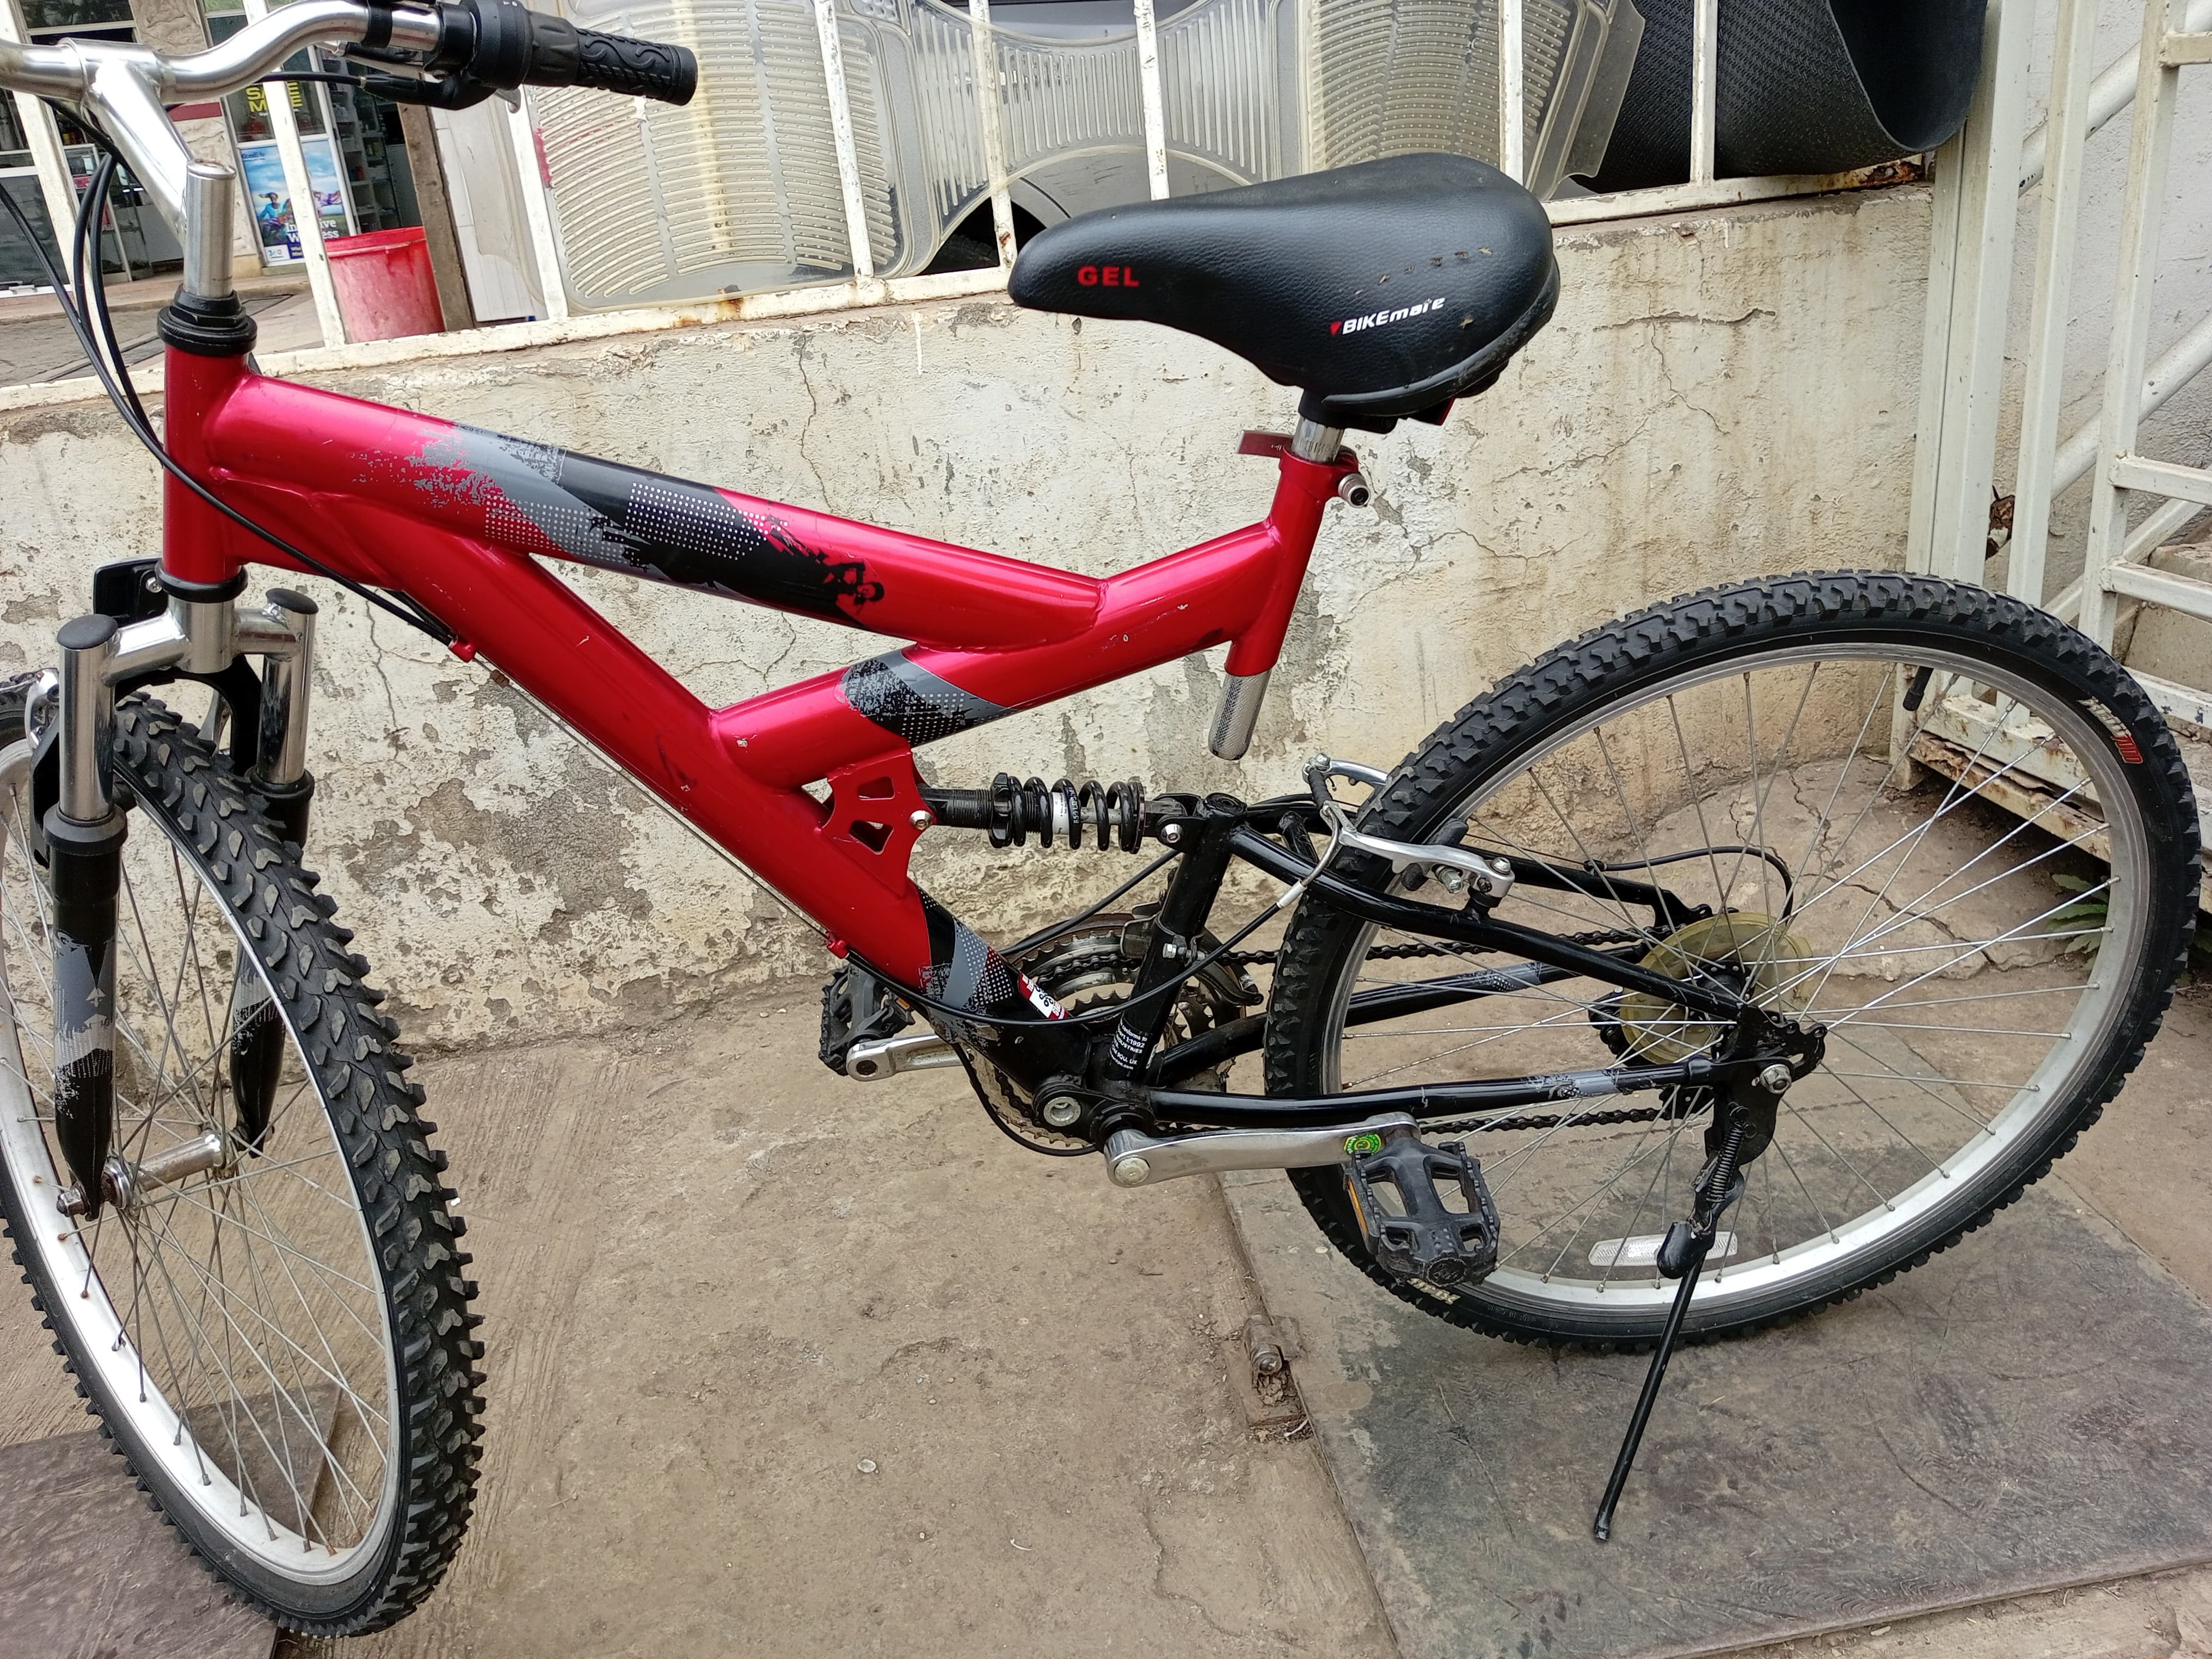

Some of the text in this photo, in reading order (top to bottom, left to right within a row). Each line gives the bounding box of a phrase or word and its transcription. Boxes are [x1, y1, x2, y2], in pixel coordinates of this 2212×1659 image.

[245, 82, 299, 100] SE
[249, 95, 303, 112] ME
[1078, 265, 1140, 287] GEL
[1342, 298, 1446, 335] BIKEmate
